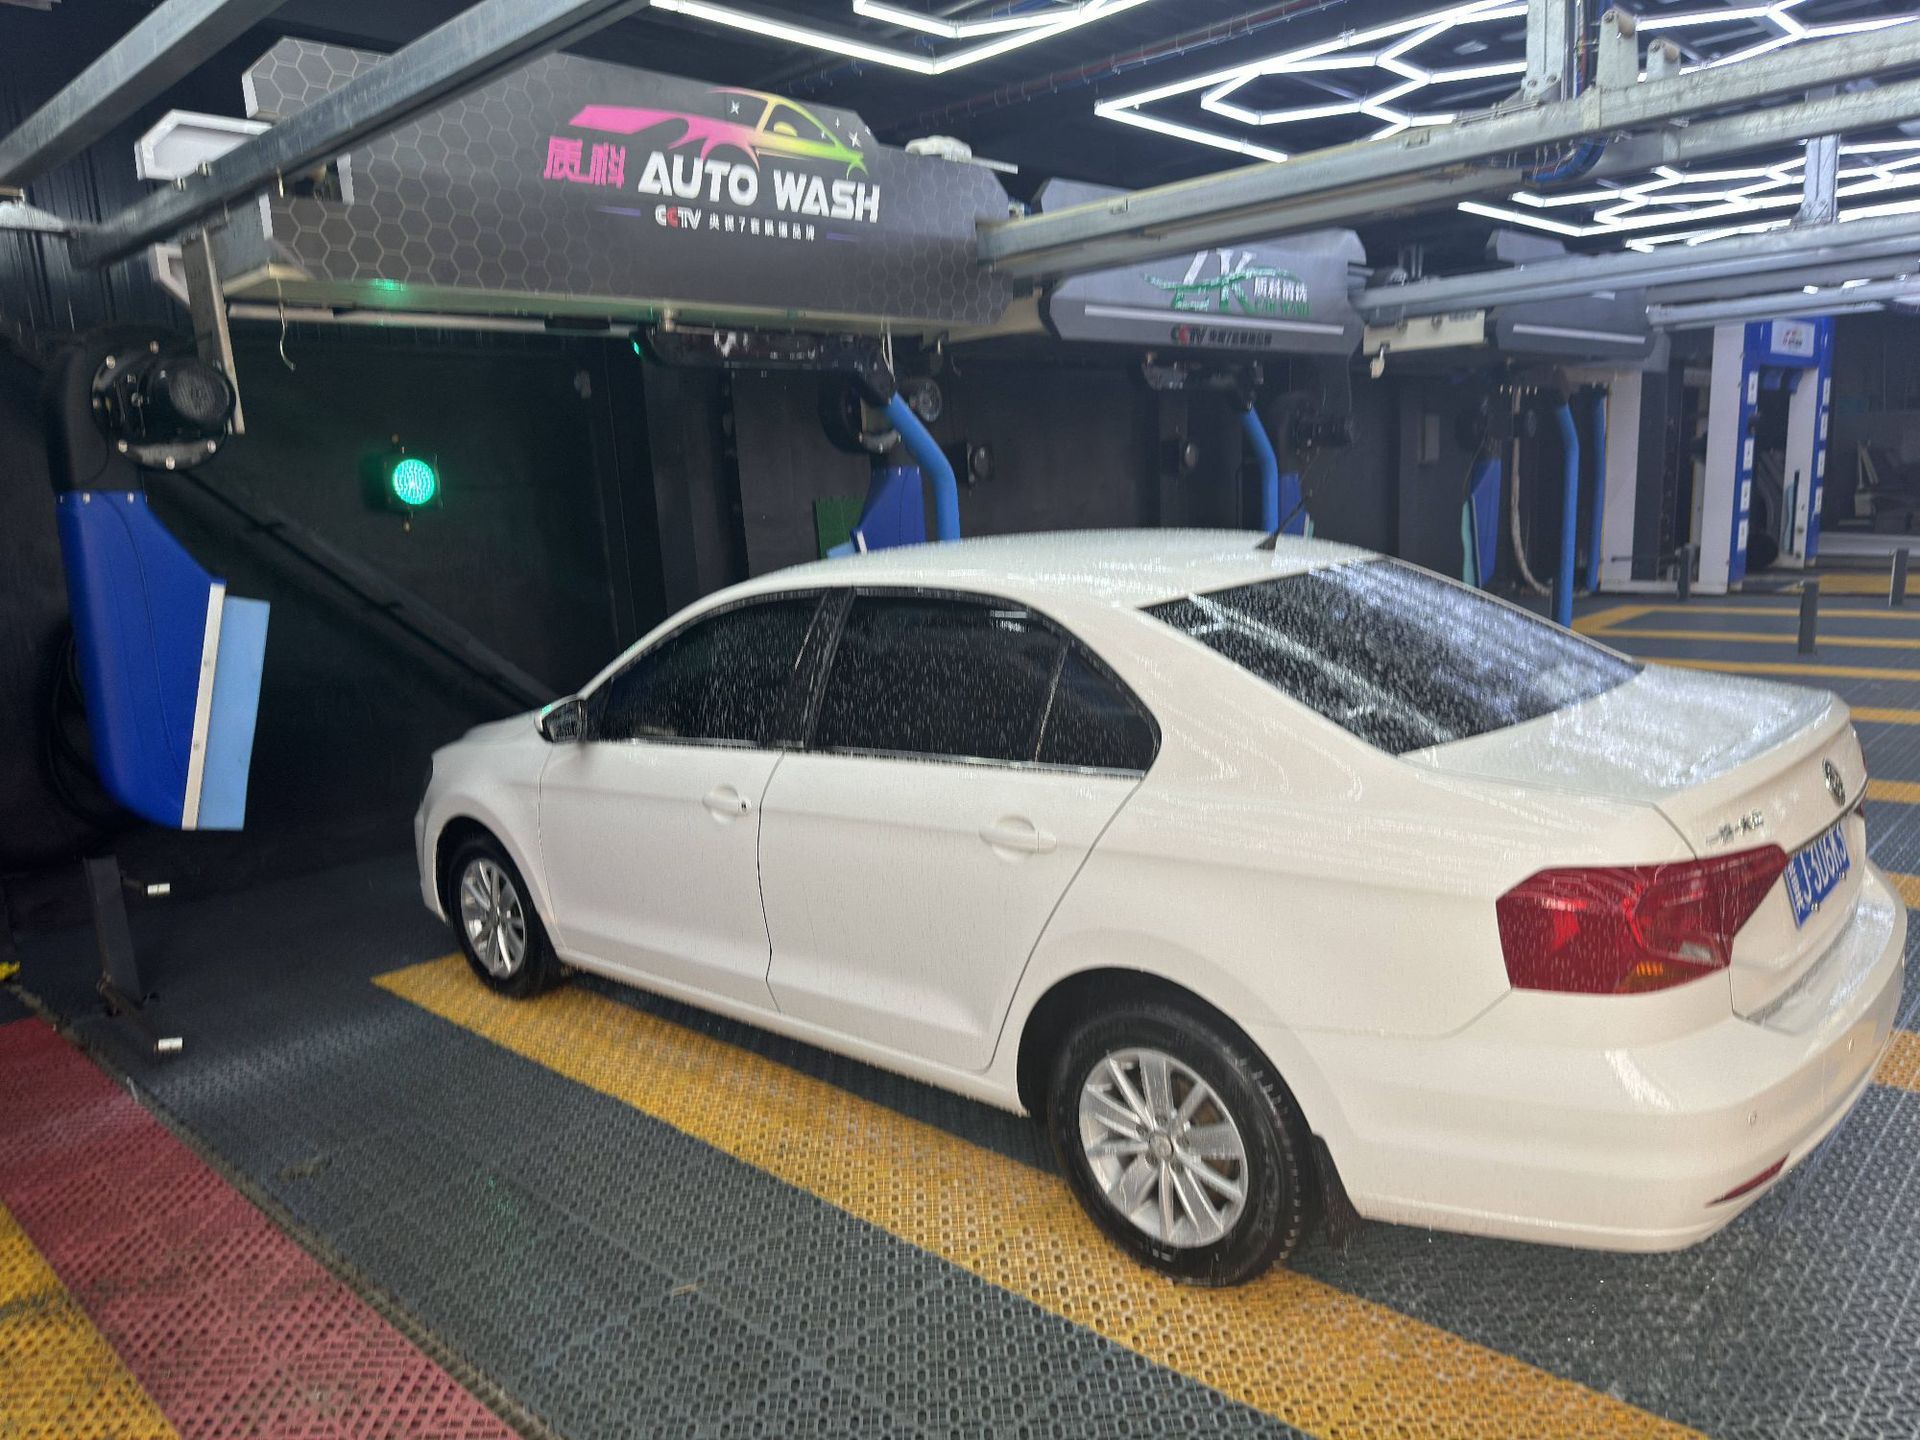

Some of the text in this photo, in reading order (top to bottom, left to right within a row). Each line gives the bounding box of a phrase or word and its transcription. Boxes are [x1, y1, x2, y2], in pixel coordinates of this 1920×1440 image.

[638, 151, 881, 223] AUTO WASH
[655, 203, 702, 231] CCTV
